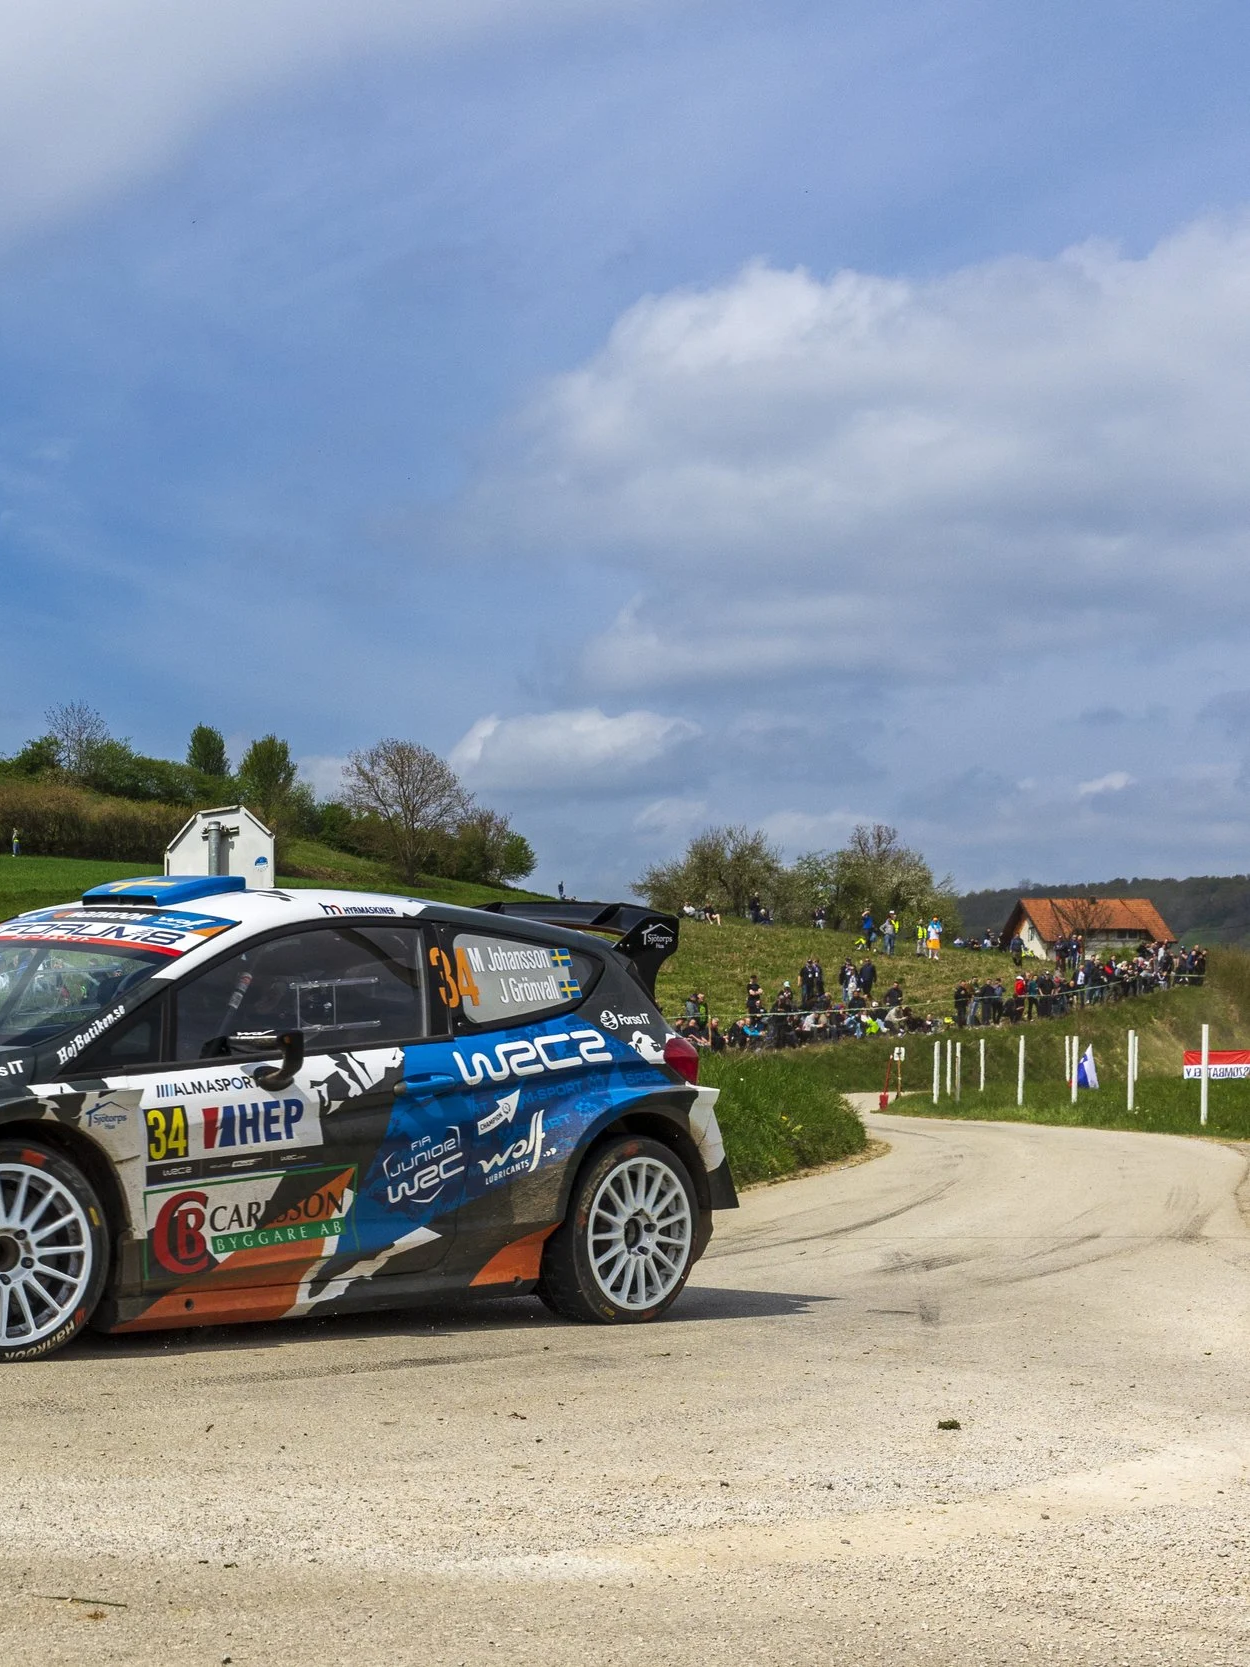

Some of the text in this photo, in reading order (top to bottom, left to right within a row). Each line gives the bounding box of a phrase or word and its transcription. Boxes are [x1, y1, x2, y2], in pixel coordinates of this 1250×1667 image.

[342, 906, 397, 915] HYRMASKINER
[429, 946, 481, 1008] 34
[467, 946, 550, 973] M Johansson
[500, 975, 560, 1004] J Grönvall
[452, 1029, 613, 1086] WRC2
[146, 1098, 304, 1160] 34 HEP
[410, 1135, 432, 1151] FIA
[477, 1109, 546, 1173] wolf
[386, 1151, 466, 1204] WRC
[390, 1137, 457, 1178] JUNIOR
[485, 1158, 530, 1186] LUBRICANTS
[209, 1191, 346, 1232] CARSON
[216, 1221, 342, 1252] BYGGARE AB
